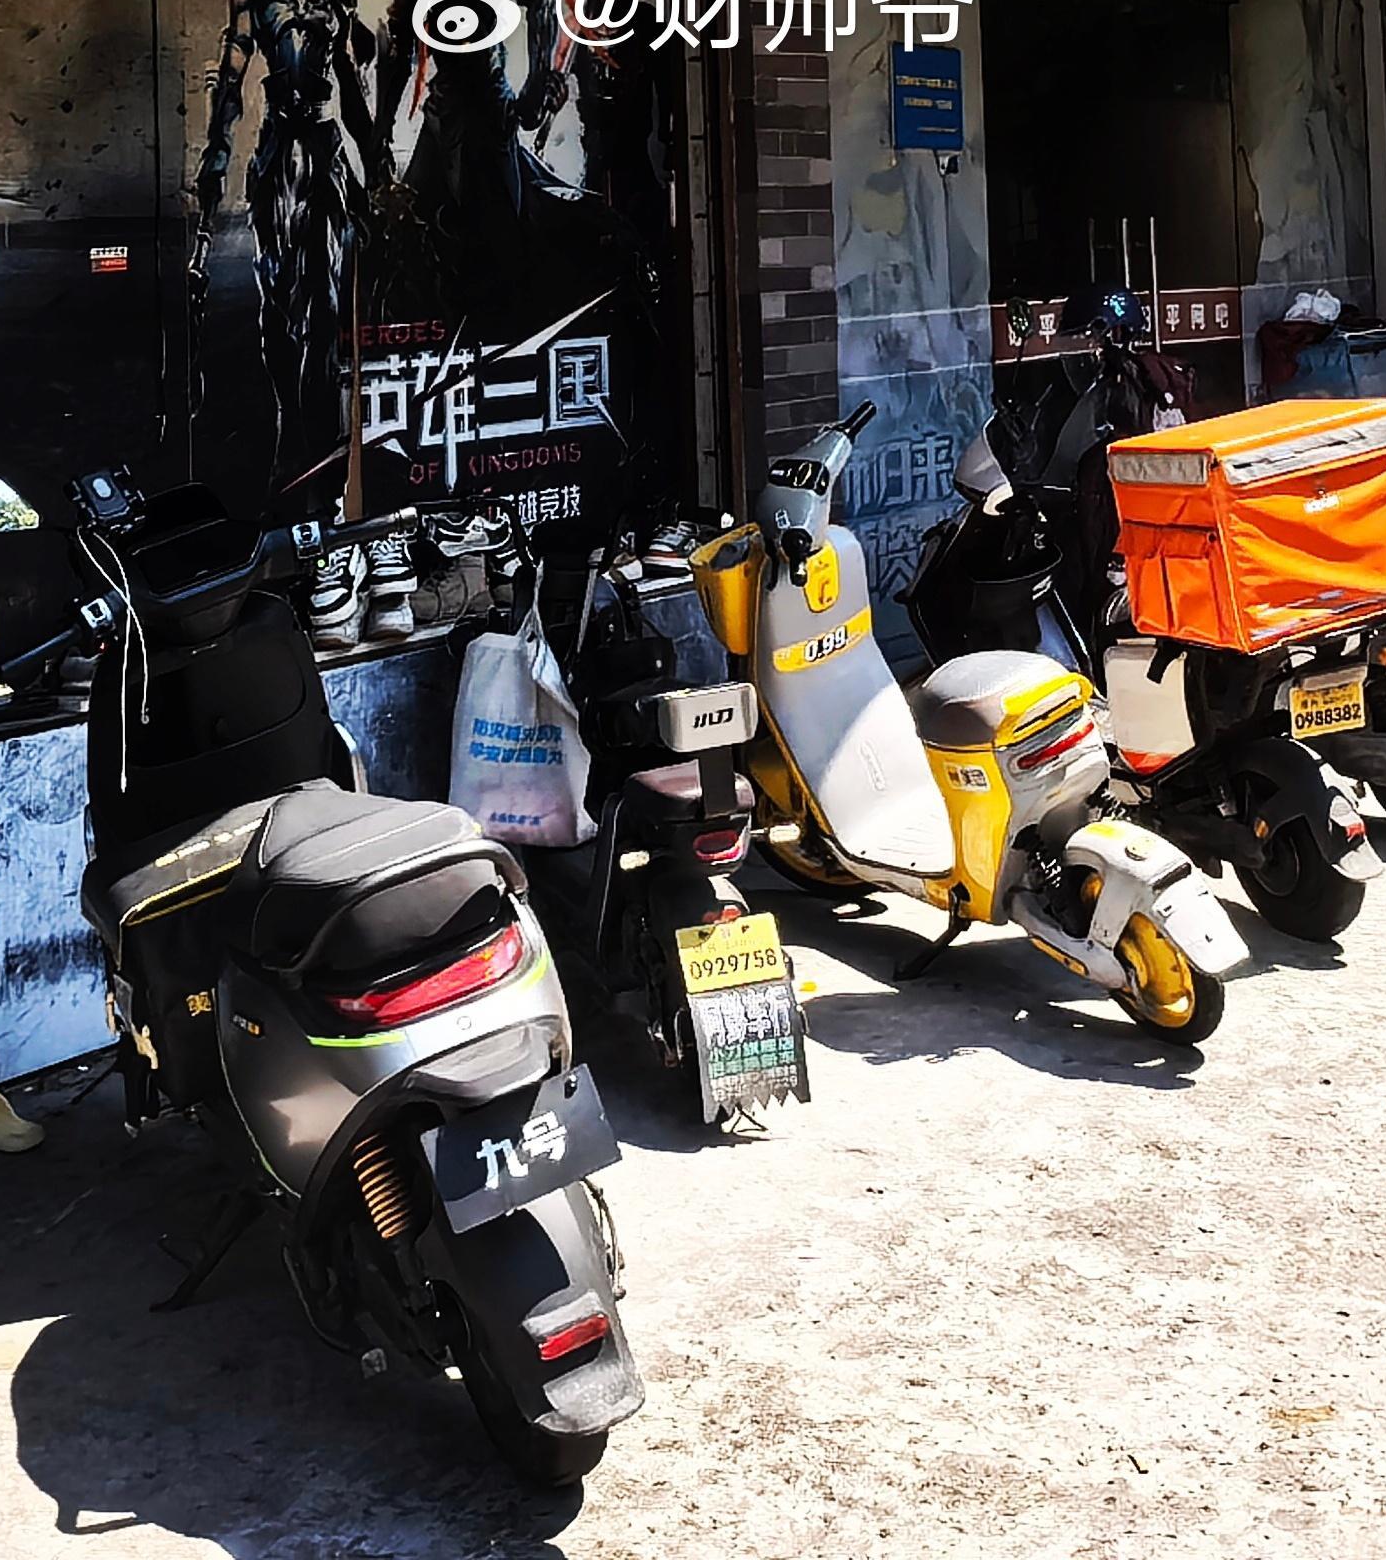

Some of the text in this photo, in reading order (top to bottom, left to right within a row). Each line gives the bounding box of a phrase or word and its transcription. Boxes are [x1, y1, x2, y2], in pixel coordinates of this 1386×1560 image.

[339, 330, 617, 492] 英雄三国
[474, 1109, 568, 1191] 九号
